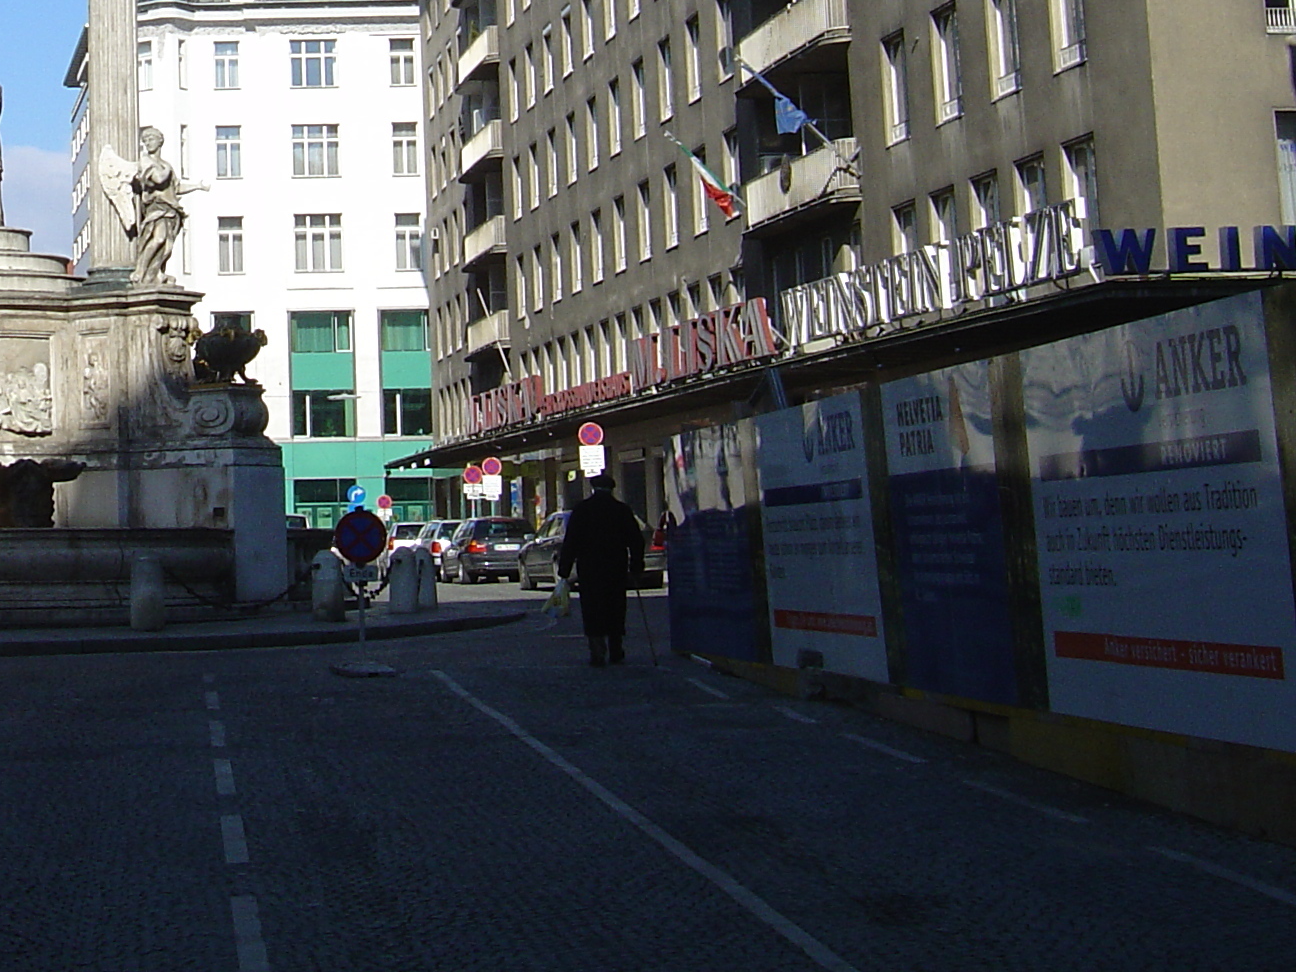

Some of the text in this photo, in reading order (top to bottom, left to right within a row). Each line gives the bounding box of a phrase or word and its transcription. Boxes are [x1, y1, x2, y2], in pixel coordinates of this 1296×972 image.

[1094, 225, 1296, 276] WEIN
[780, 245, 952, 346] WEINSTEIN
[1155, 324, 1248, 400] ANKER
[896, 395, 943, 427] HELVETIA
[817, 411, 856, 455] ANKER
[899, 429, 935, 457] PATRIA
[1105, 491, 1127, 516] denn
[1129, 489, 1144, 514] wir
[1184, 491, 1202, 512] aus
[1204, 480, 1258, 510] Tradition
[1104, 637, 1129, 659] Anker
[1131, 640, 1177, 663] versichert
[1188, 643, 1219, 666] sicher
[1223, 647, 1278, 673] verankert
